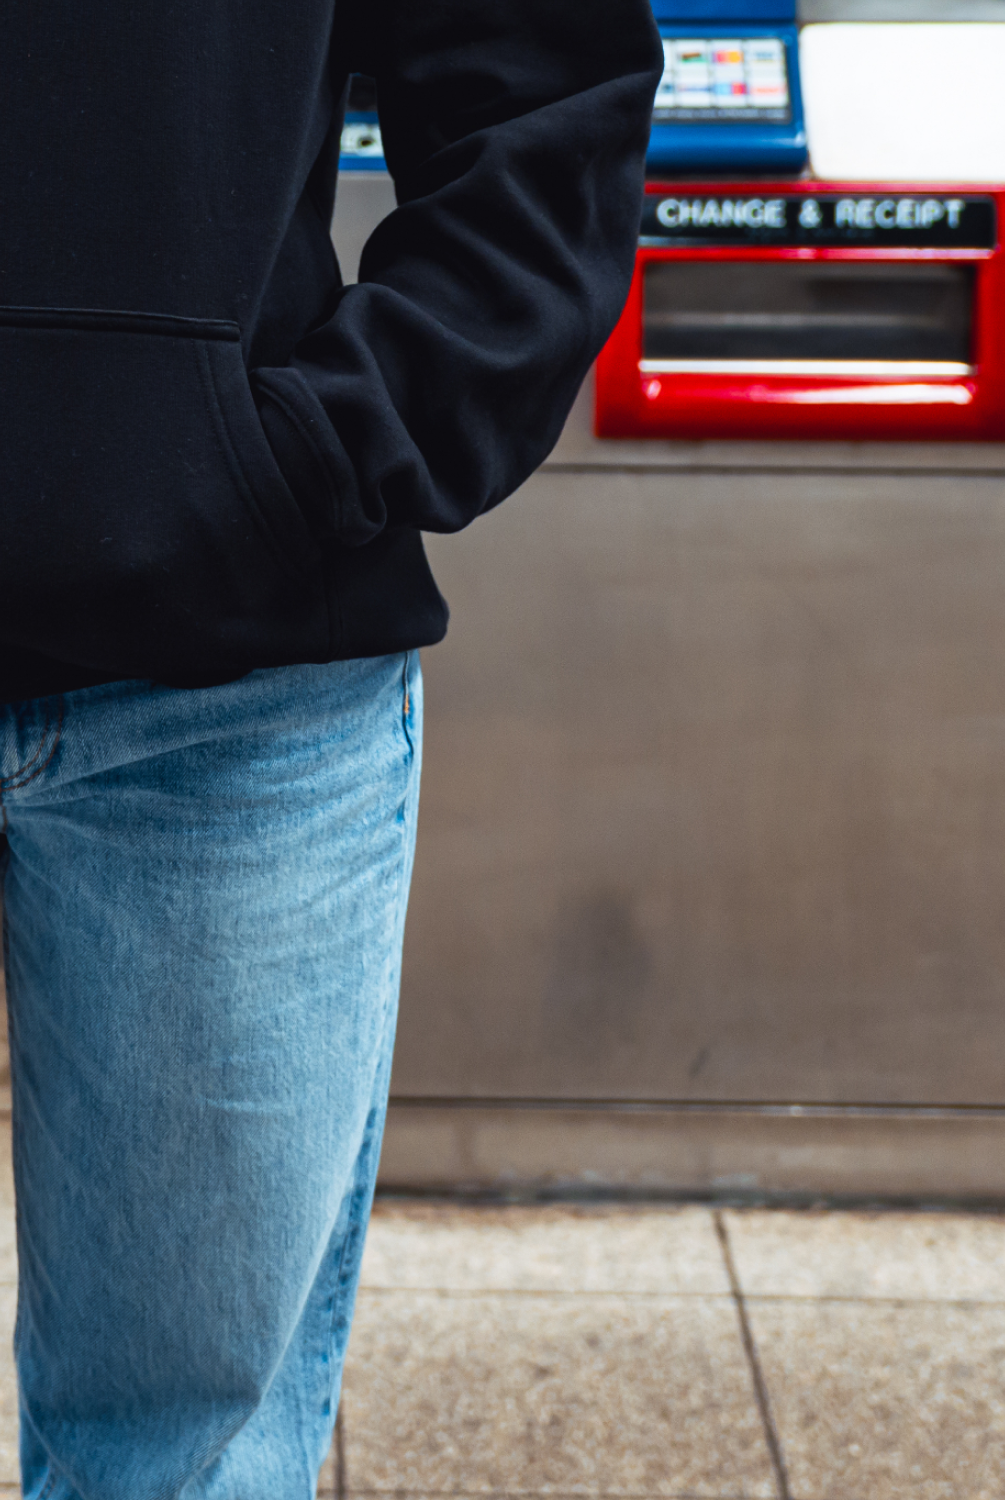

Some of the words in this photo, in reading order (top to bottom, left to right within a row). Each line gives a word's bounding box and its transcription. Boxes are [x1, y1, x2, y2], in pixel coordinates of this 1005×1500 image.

[656, 199, 787, 228] CHANGE
[798, 199, 823, 228] &
[835, 199, 965, 229] RECEIPT
